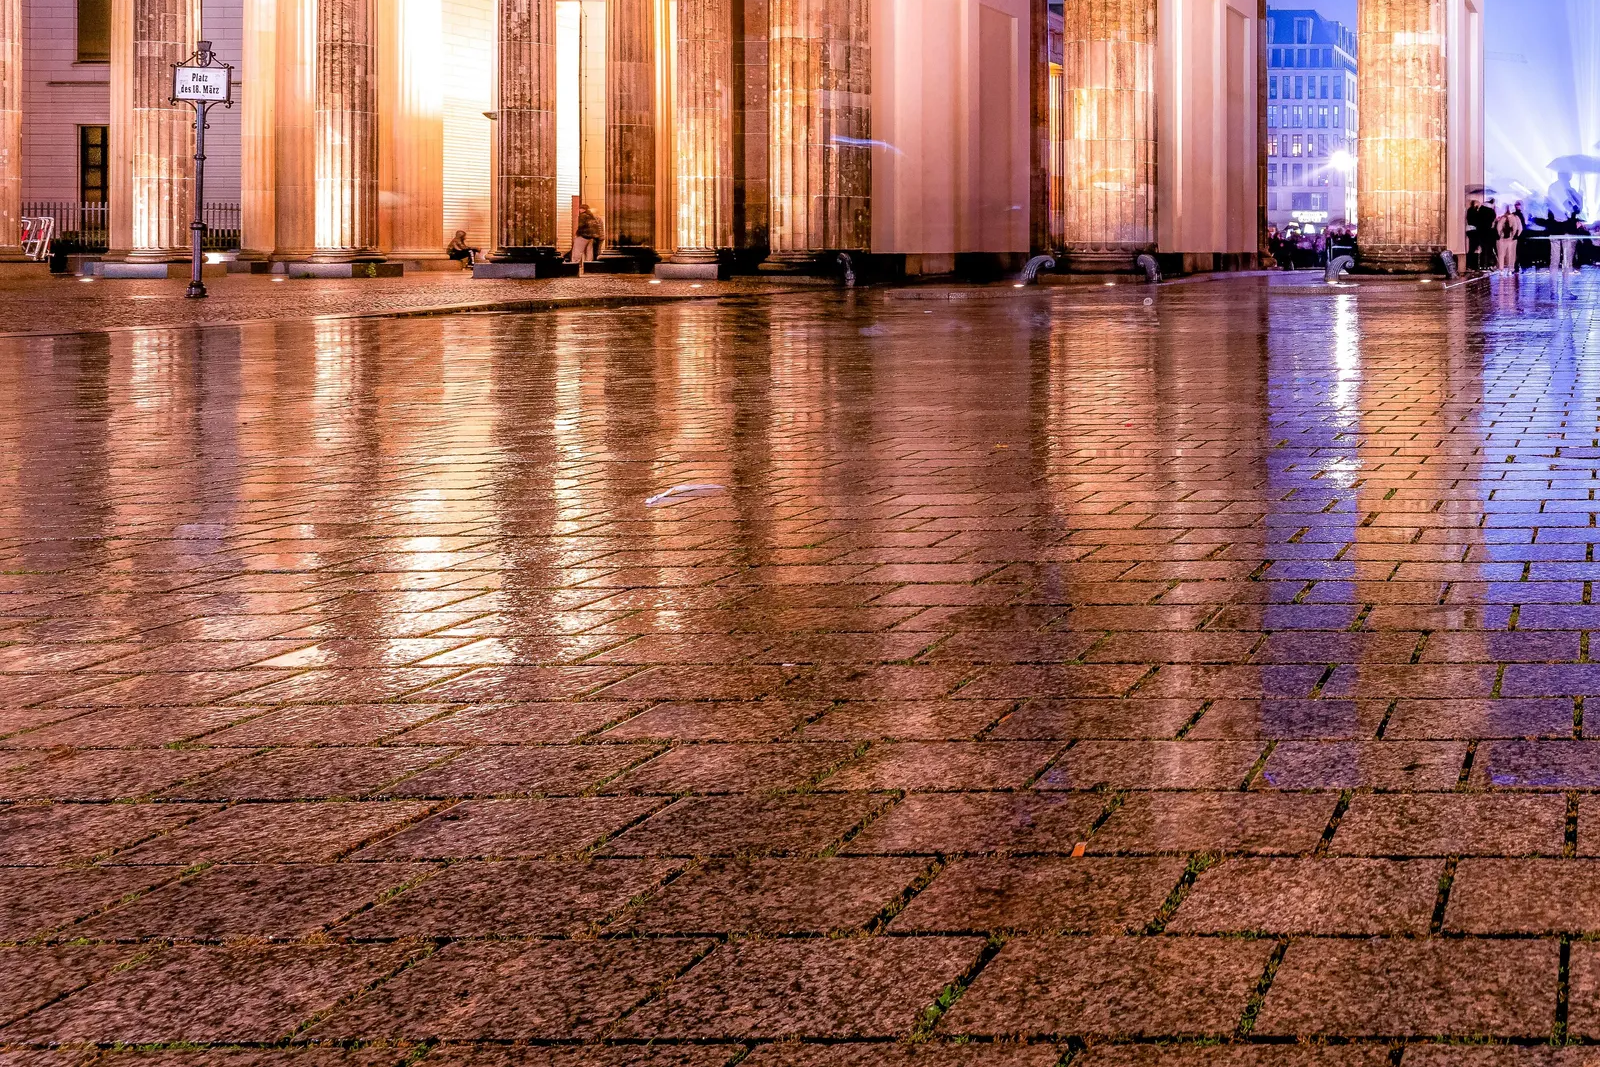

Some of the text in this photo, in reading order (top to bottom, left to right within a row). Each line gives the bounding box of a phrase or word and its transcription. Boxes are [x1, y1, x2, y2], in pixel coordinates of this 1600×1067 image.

[191, 72, 209, 82] Platz
[180, 84, 191, 93] des
[202, 85, 220, 94] März
